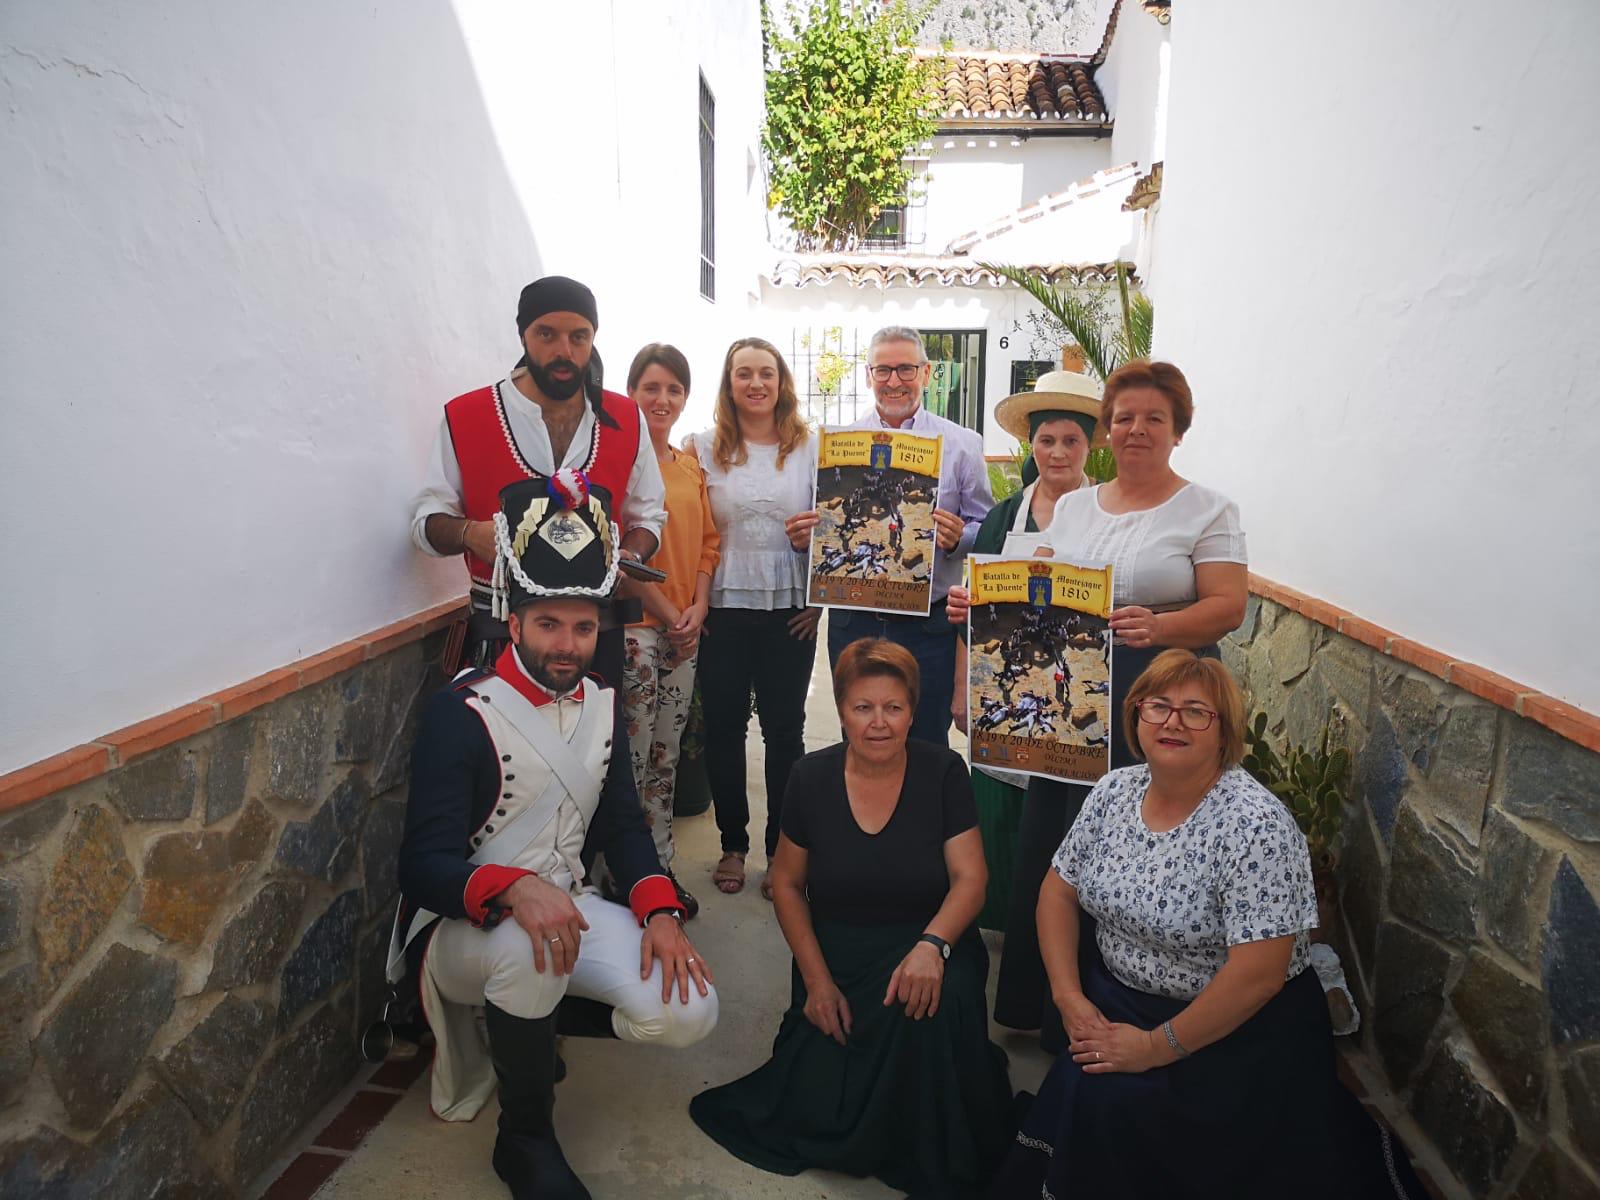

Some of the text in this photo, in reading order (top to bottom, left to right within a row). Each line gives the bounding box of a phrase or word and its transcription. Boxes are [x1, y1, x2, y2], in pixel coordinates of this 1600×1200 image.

[999, 336, 1009, 349] 6
[900, 453, 924, 464] 1810
[1011, 572, 1020, 580] de
[1056, 576, 1102, 590] Montejaque
[1062, 586, 1090, 600] 1810
[1010, 736, 1022, 746] 20
[1027, 738, 1043, 748] DE
[1046, 741, 1105, 758] OCTUBRE
